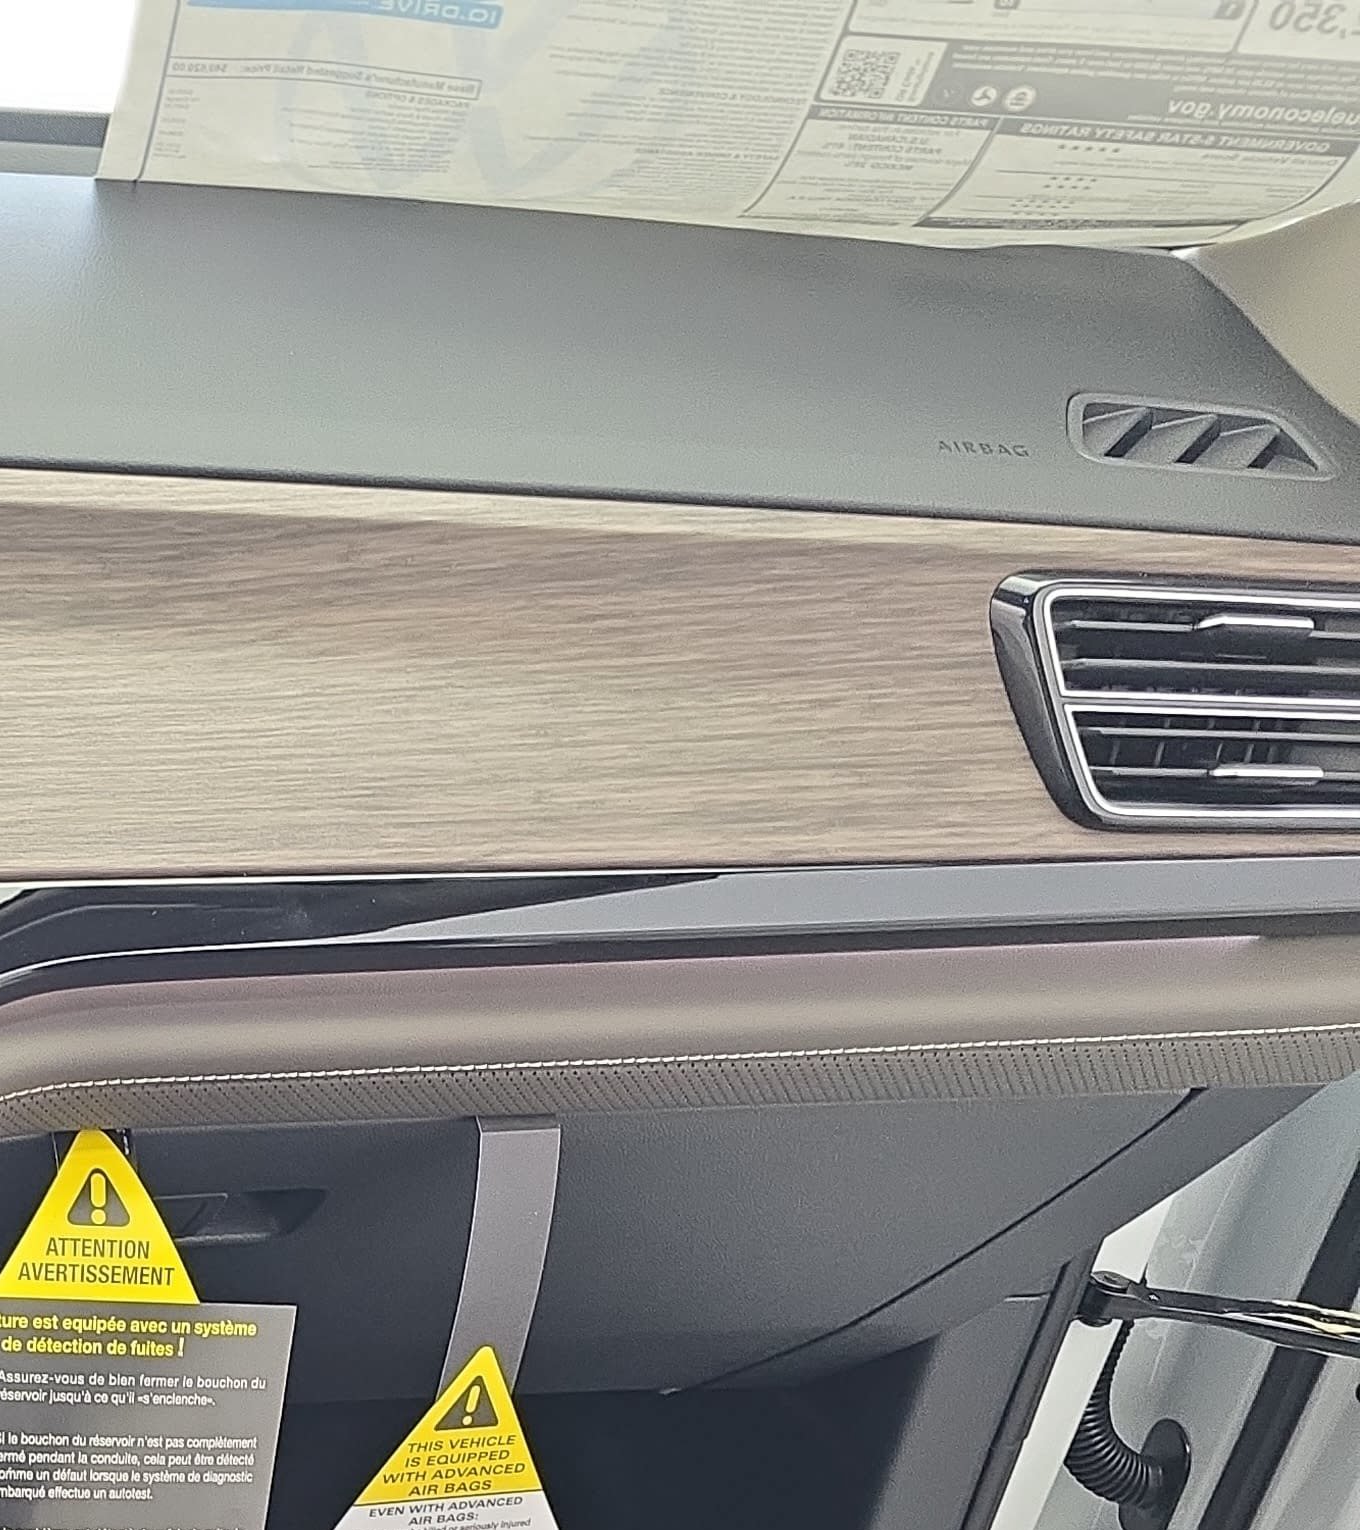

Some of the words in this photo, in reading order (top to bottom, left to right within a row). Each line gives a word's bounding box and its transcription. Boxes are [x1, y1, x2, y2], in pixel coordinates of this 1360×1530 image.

[938, 440, 1030, 458] AIRBAG
[45, 1237, 150, 1260] ATTENTION
[18, 1262, 176, 1286] AVERTISSEMENT
[32, 1315, 59, 1329] est
[62, 1316, 126, 1333] equipée
[130, 1320, 167, 1333] avec
[171, 1321, 190, 1338] un
[193, 1320, 256, 1337] système
[0, 1335, 22, 1351] de
[26, 1337, 102, 1354] détection
[106, 1339, 127, 1355] de
[130, 1340, 174, 1356] fuites
[177, 1339, 184, 1357] !
[88, 1372, 105, 1385] de
[108, 1373, 135, 1386] bien
[139, 1374, 180, 1387] fermer
[182, 1375, 193, 1388] le
[196, 1376, 248, 1389] bouchon
[250, 1376, 266, 1389] du
[93, 1392, 108, 1403] ce
[110, 1391, 135, 1406] qu'il
[8, 1431, 18, 1444] le
[20, 1432, 69, 1445] bouchon
[71, 1434, 86, 1446] du
[88, 1434, 136, 1447] réservoir
[136, 1435, 163, 1448] n'est
[165, 1438, 184, 1450] pas
[186, 1436, 257, 1449] complètement
[407, 1440, 444, 1453] THIS
[449, 1434, 516, 1449] VEHICLE
[28, 1451, 75, 1465] pendant
[77, 1451, 88, 1464] la
[90, 1452, 140, 1465] conduite,
[143, 1453, 166, 1465] cela
[167, 1454, 192, 1467] peut
[216, 1453, 254, 1465] détecté
[404, 1456, 421, 1468] IS
[426, 1449, 510, 1466] EQUIPPED
[35, 1470, 50, 1481] un
[52, 1468, 87, 1481] défaut
[89, 1469, 129, 1484] lorsque
[130, 1469, 140, 1482] le
[142, 1470, 185, 1484] système
[187, 1470, 200, 1482] de
[202, 1471, 253, 1485] diagnostic
[382, 1470, 427, 1484] WITH
[430, 1463, 525, 1479] ADVANCED
[47, 1486, 91, 1499] effectue
[93, 1489, 107, 1499] un
[108, 1487, 153, 1499] autotest.
[408, 1485, 438, 1497] AIR
[444, 1480, 492, 1493] BAGS
[368, 1506, 405, 1517] EVEN
[408, 1503, 445, 1515] WITH
[447, 1496, 523, 1510] ADVANCED
[407, 1515, 432, 1526] AIR
[436, 1511, 479, 1524] BAGS:
[500, 1518, 531, 1529] injured
